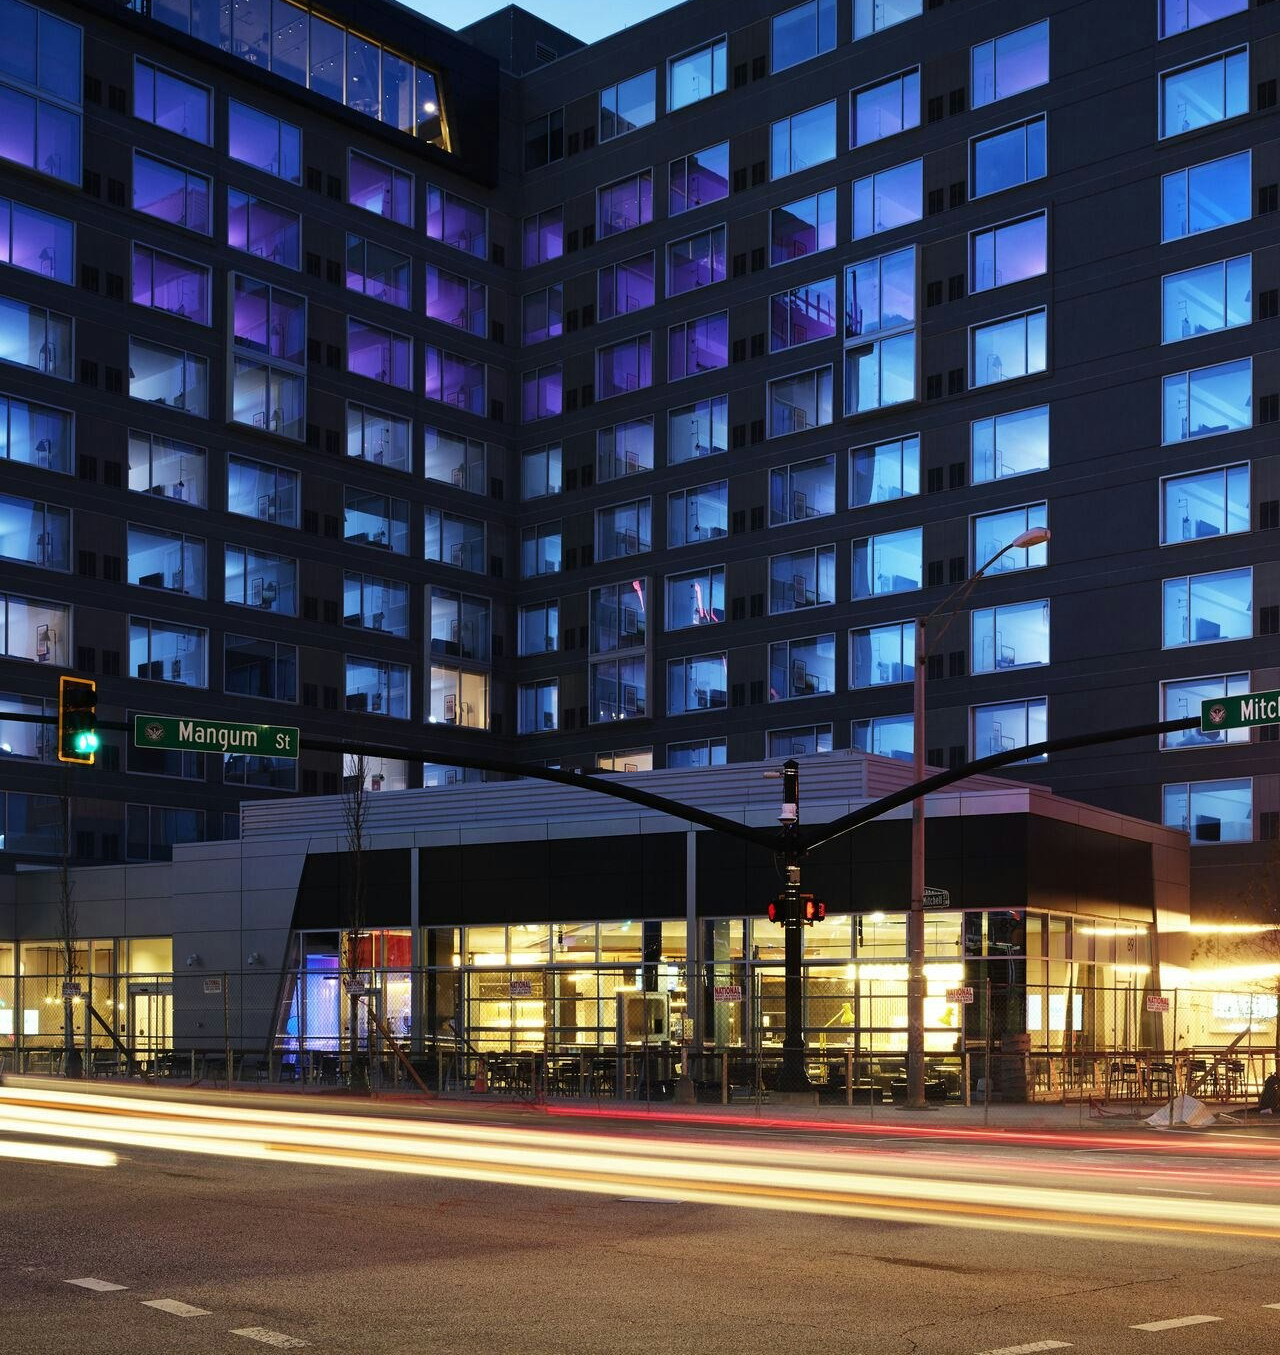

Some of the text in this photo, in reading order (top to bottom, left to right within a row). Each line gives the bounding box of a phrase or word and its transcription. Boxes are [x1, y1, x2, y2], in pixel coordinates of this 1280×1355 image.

[178, 720, 291, 751] Mangum St
[715, 986, 741, 995] NATIONAL
[946, 987, 973, 998] NATIONAL
[1147, 996, 1169, 1006] NATIONAL
